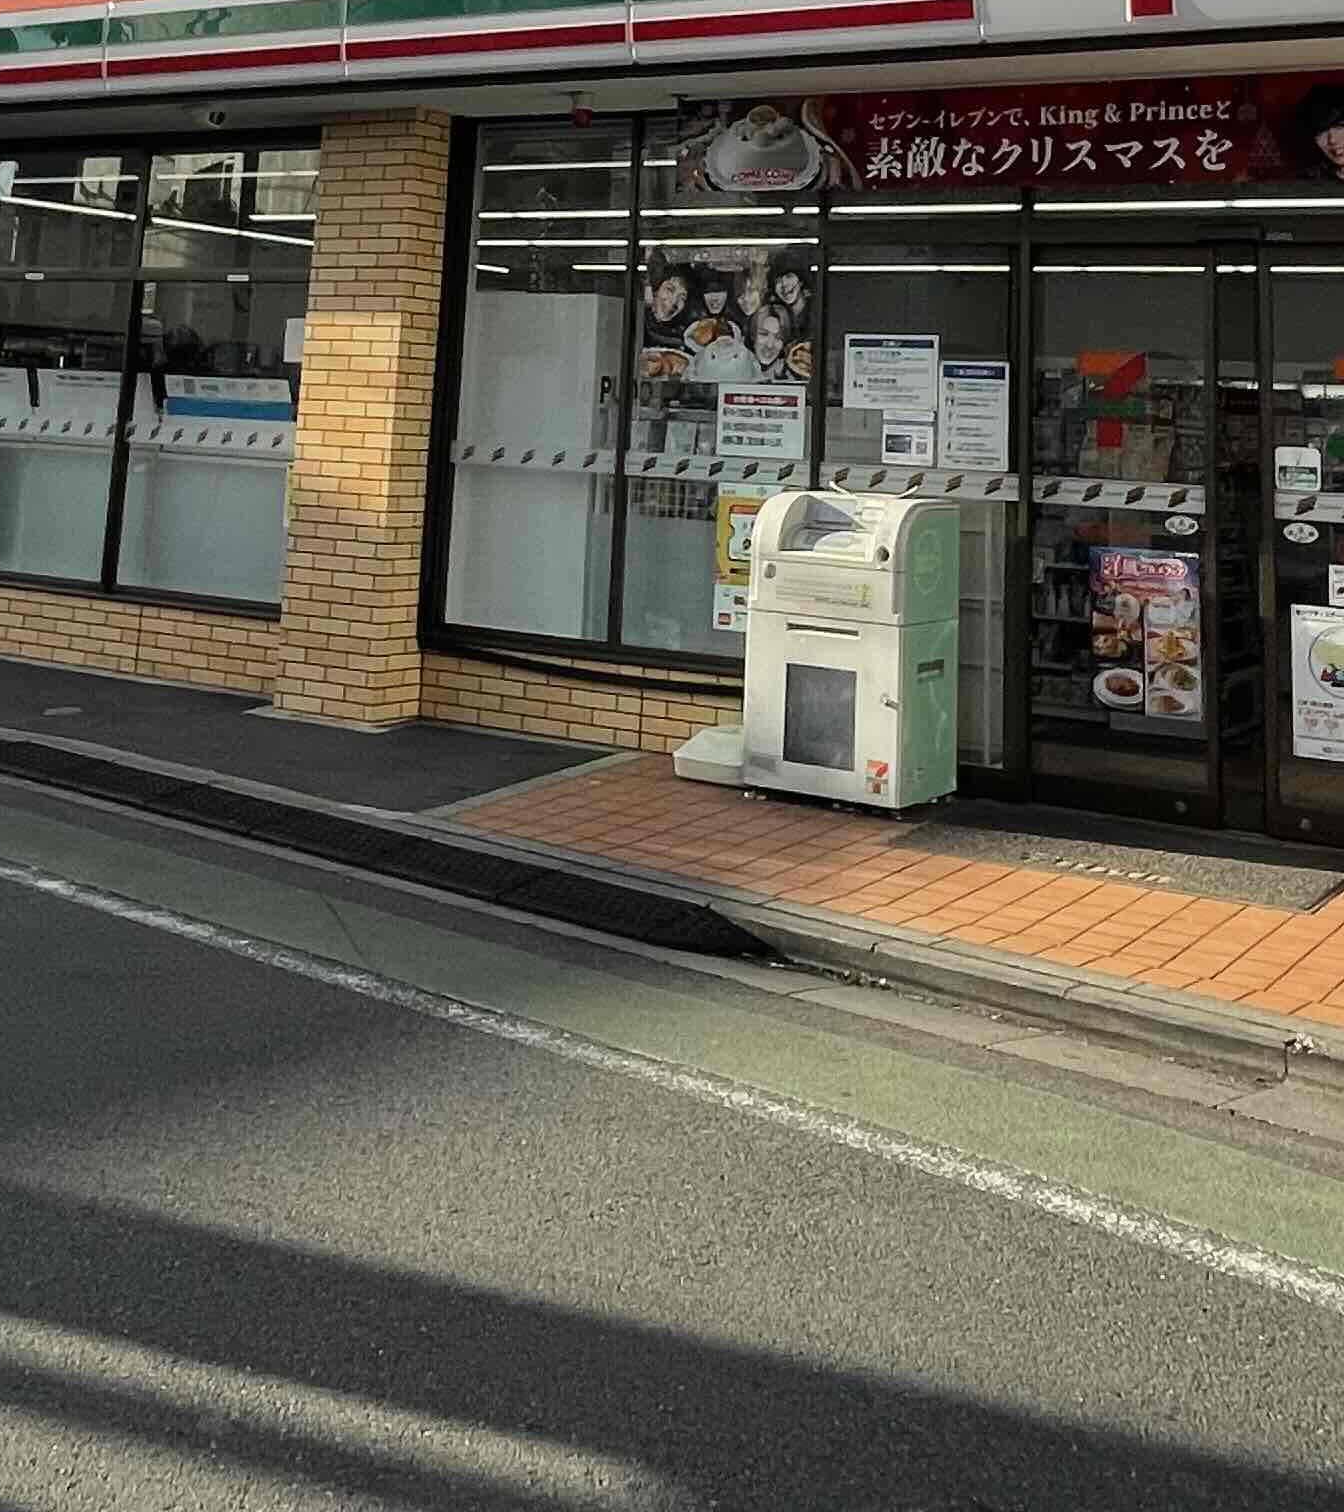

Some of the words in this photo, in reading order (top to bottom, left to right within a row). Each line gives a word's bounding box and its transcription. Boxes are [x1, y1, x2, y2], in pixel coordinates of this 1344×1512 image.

[1038, 104, 1100, 130] King
[1104, 102, 1123, 123] &
[864, 128, 1234, 180] 素敵なクリスマスを
